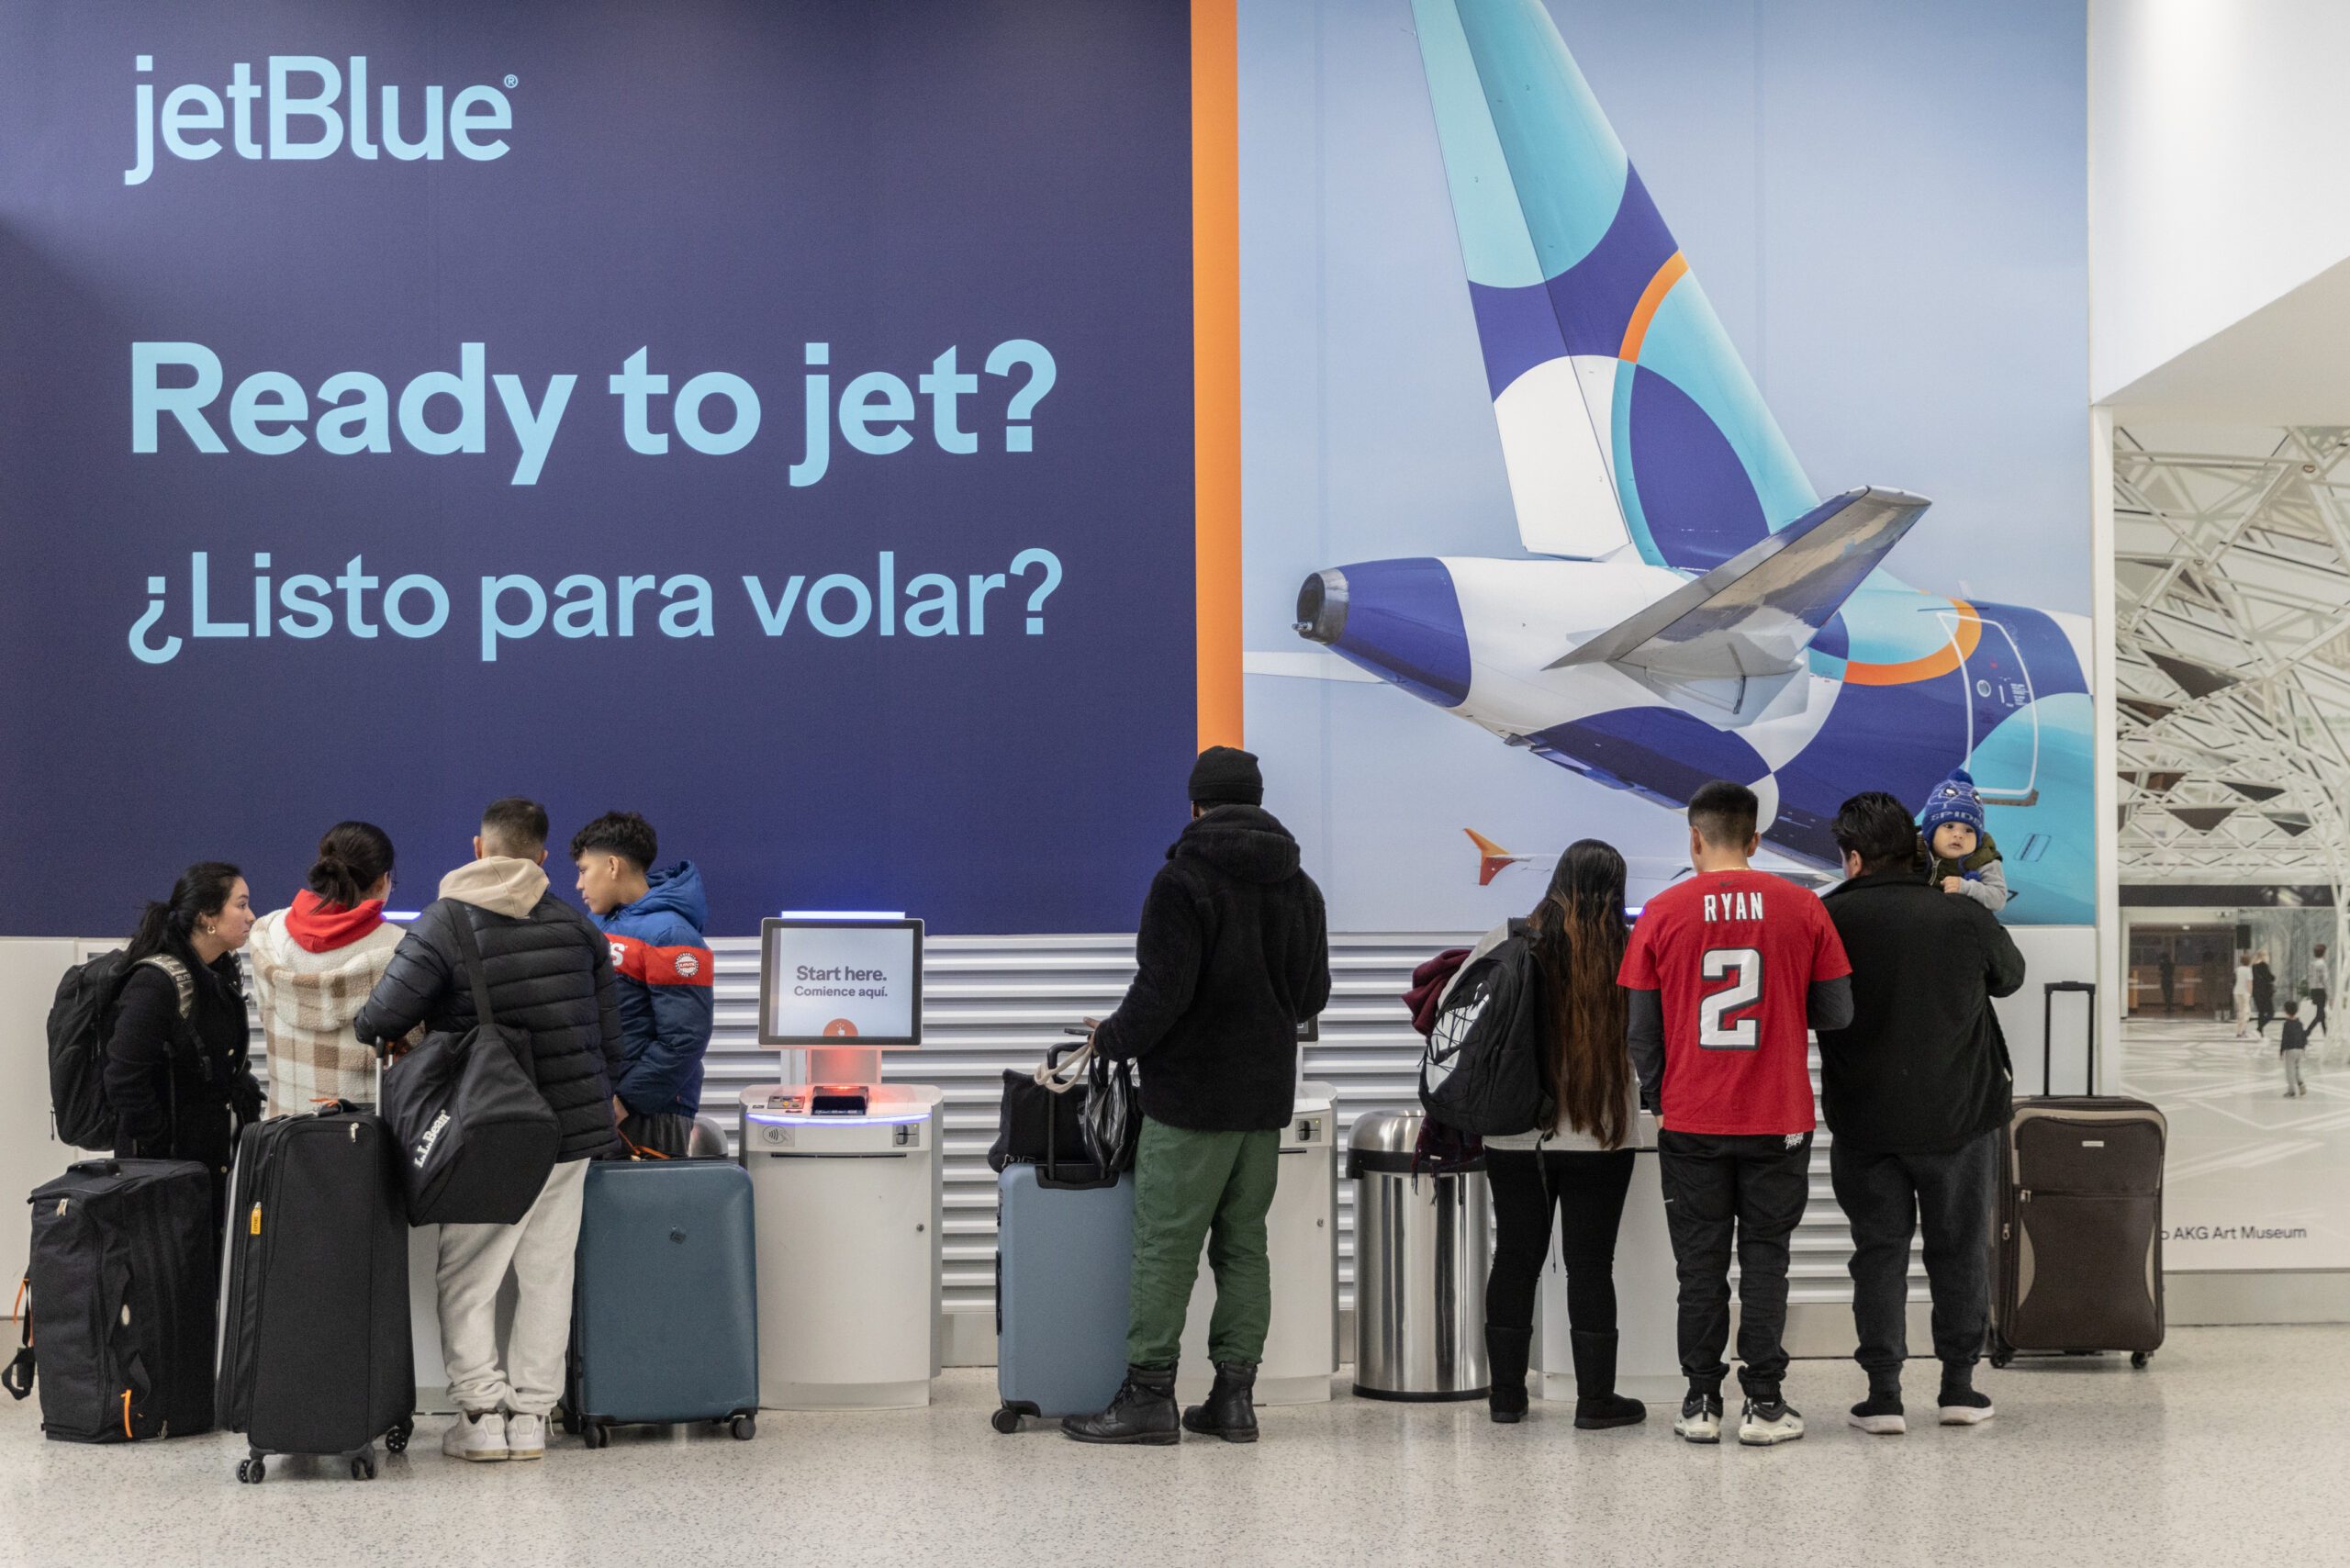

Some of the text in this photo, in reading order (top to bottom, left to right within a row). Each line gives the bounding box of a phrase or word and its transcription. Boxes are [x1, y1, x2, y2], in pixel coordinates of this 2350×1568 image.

[132, 339, 1057, 487] Ready to jet?
[129, 547, 1062, 664] ¿Listo para volar?
[1704, 892, 1763, 922] RYAN
[796, 965, 888, 981] Start here.
[794, 985, 889, 1000] Comience aquí.
[1699, 947, 1762, 1050] 2
[2173, 1226, 2209, 1240] AKG
[2212, 1226, 2237, 1240] Art
[2241, 1226, 2307, 1239] Museum
